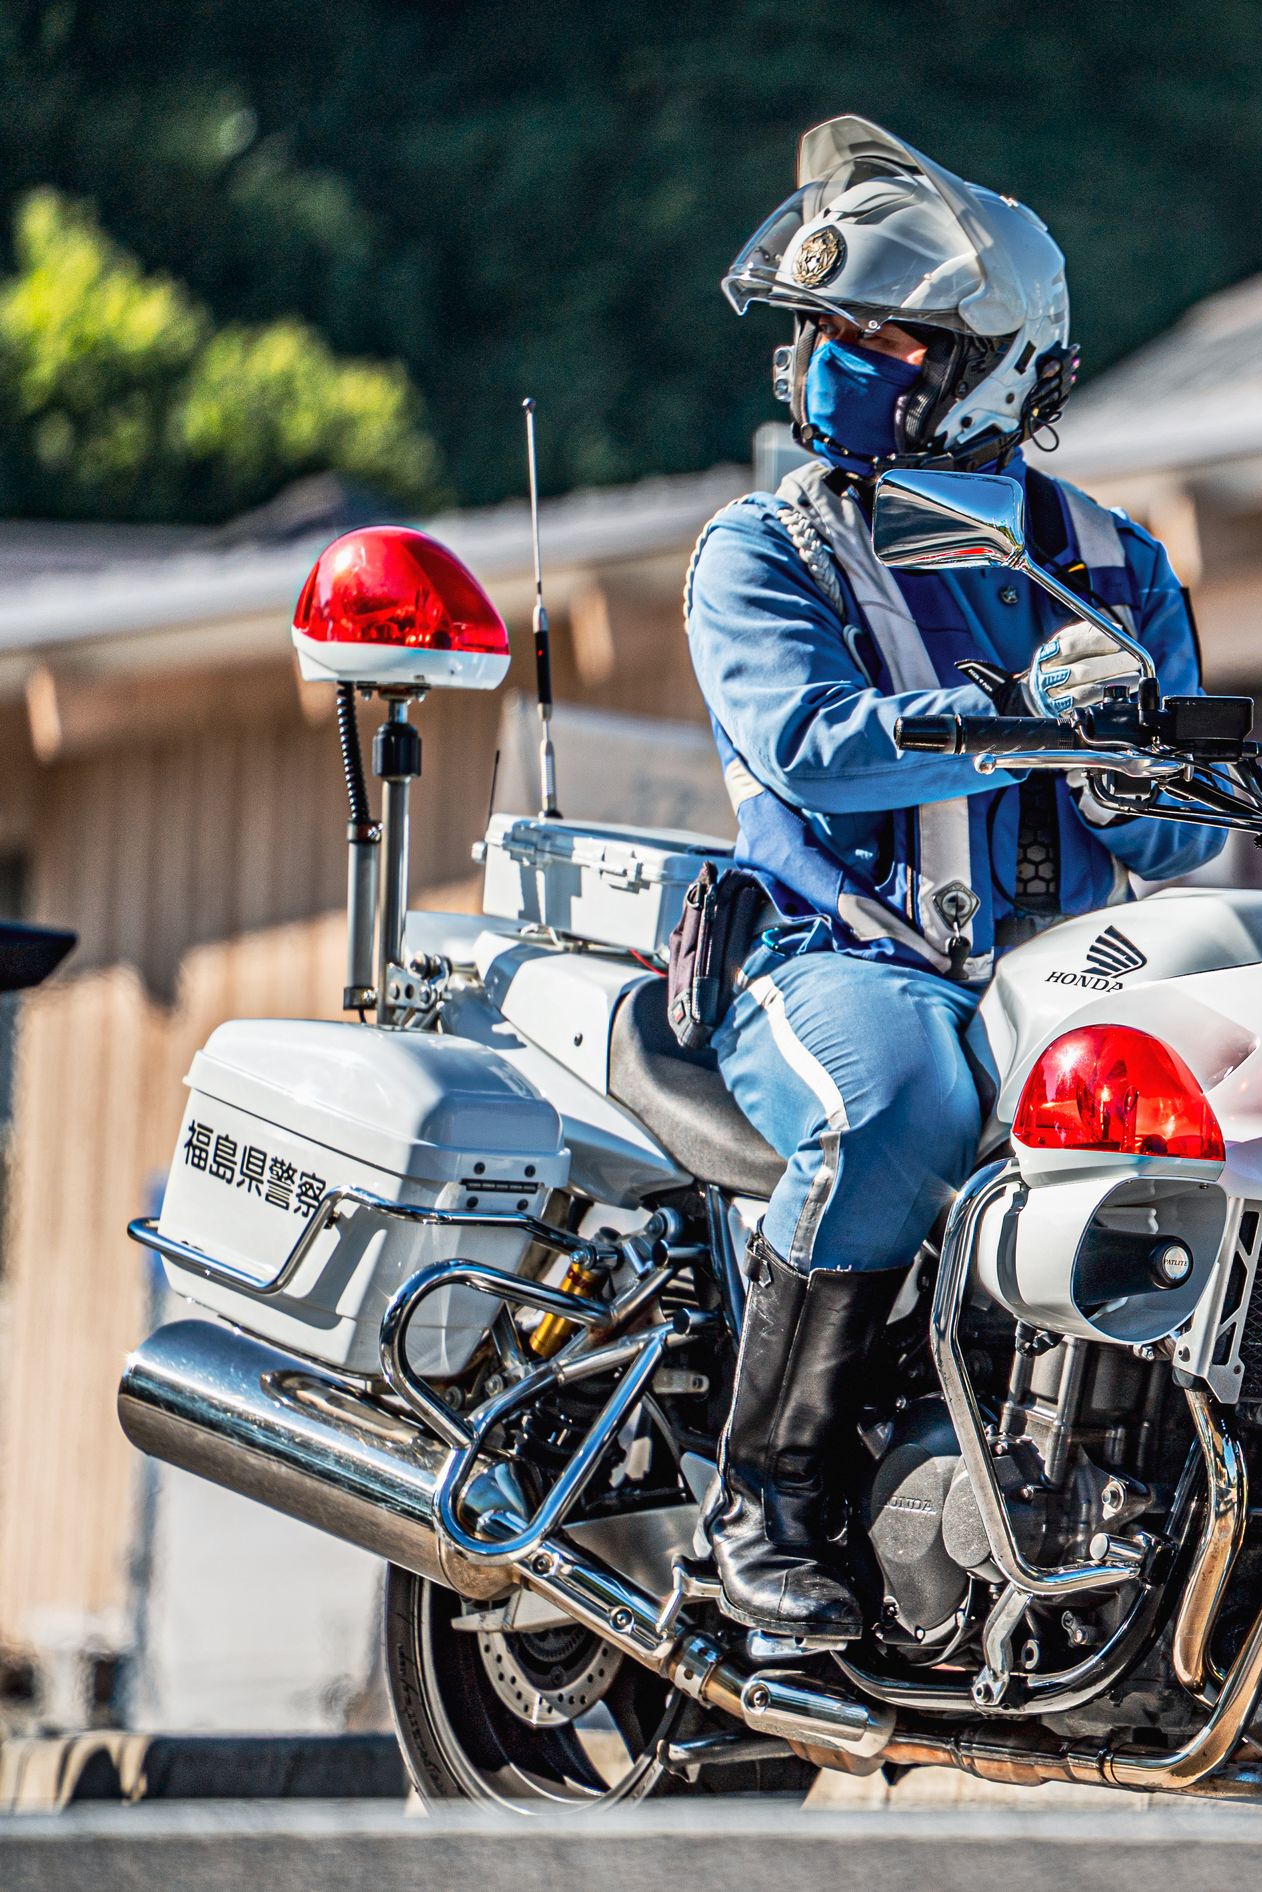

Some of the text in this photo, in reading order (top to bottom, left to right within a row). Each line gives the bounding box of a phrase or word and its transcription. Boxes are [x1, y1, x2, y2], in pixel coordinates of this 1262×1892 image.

[1045, 971, 1124, 993] HONDA
[184, 1119, 327, 1218] 福島県警察
[1163, 1258, 1188, 1267] PATLITE
[882, 1495, 936, 1515] ONDA
